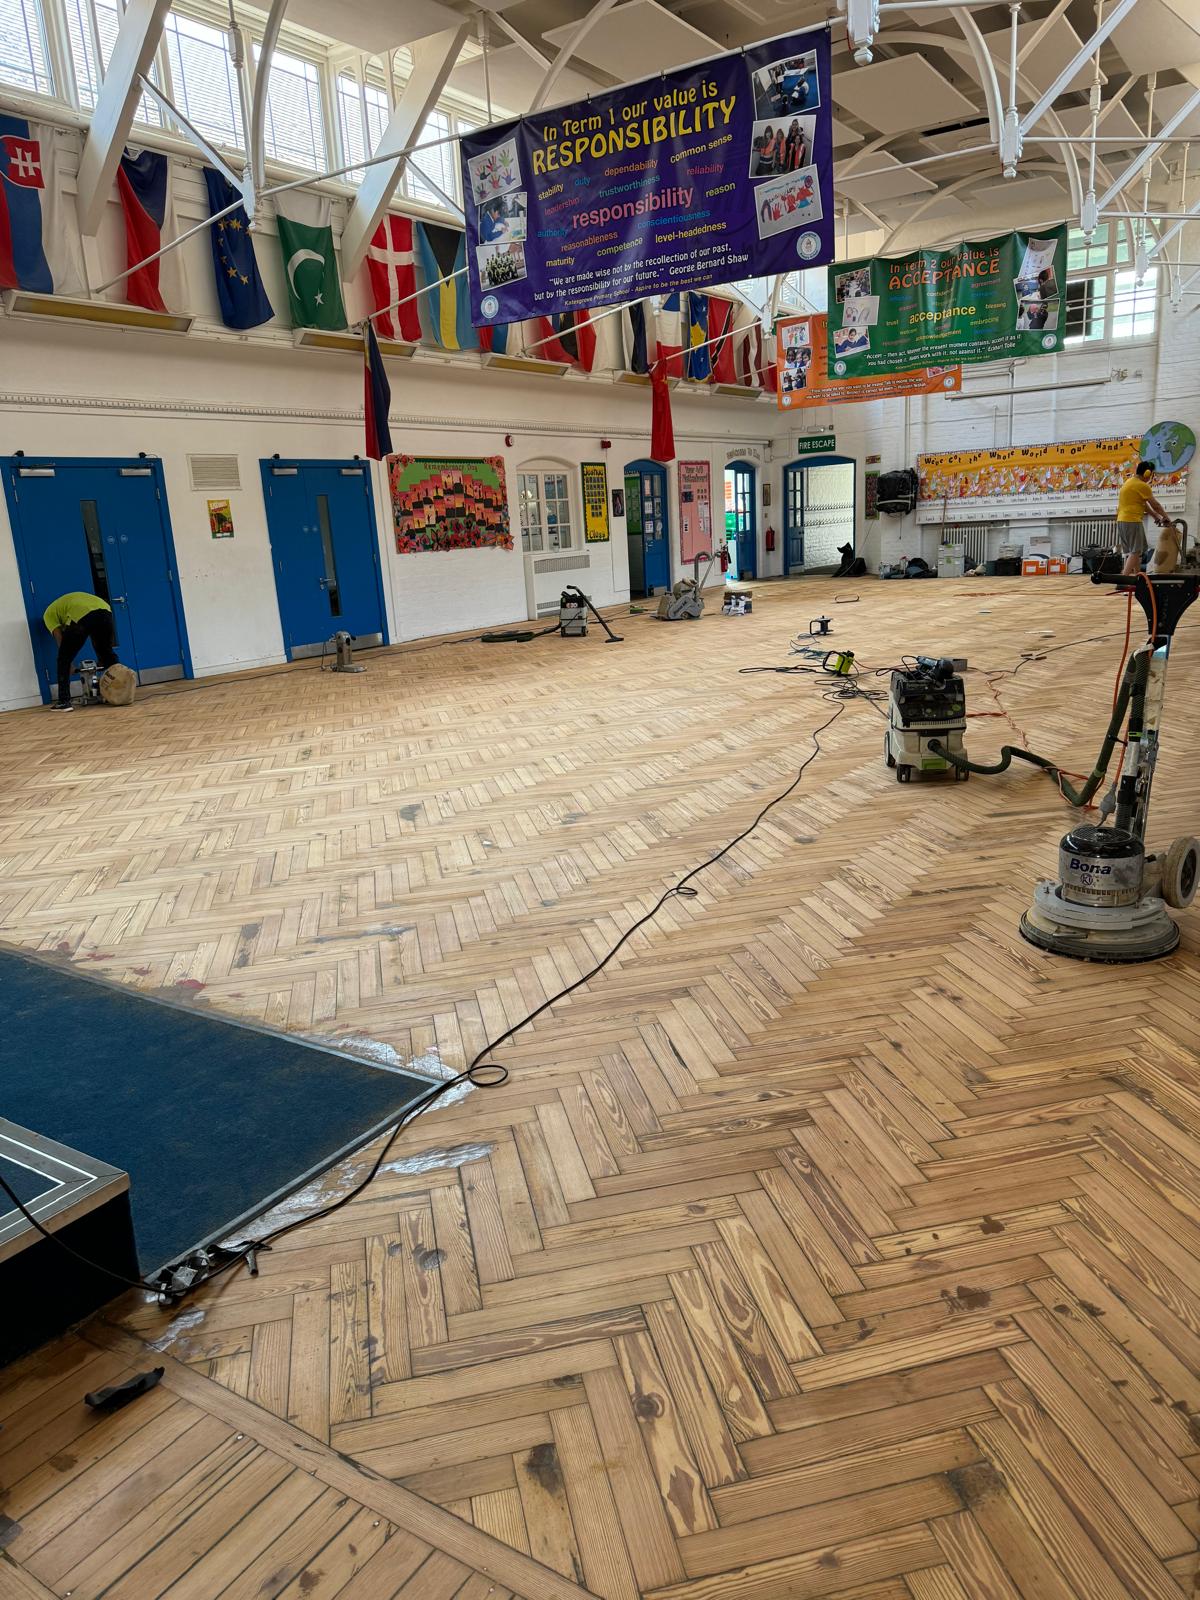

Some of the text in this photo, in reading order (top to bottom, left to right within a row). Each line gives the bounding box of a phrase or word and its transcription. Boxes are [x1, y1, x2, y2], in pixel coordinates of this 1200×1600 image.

[544, 79, 718, 142] In Term 1 our value is
[532, 95, 736, 176] RESPONSIBILITY
[670, 134, 733, 164] common sense
[604, 159, 658, 176] dependability
[686, 163, 724, 176] reliability
[538, 184, 564, 200] stability
[599, 175, 660, 198] trustworthiness
[706, 182, 736, 198] reason
[544, 197, 582, 216] leadership
[572, 186, 694, 229] responsibility
[637, 210, 711, 230] conscientiousness
[561, 231, 618, 252] reasonableness
[656, 221, 727, 244] level-headedness
[597, 237, 643, 256] competence
[546, 256, 575, 268] maturity
[564, 275, 575, 284] are
[576, 271, 594, 282] made
[595, 268, 610, 278] wise
[612, 264, 623, 274] not
[624, 262, 632, 272] by
[633, 260, 643, 269] the
[645, 252, 689, 267] recollection
[690, 248, 698, 259] of
[699, 248, 711, 256] our
[890, 248, 1000, 274] In Term 2 our value is
[534, 292, 544, 301] but
[546, 290, 554, 299] by
[556, 288, 567, 298] the
[568, 280, 611, 296] responsibility
[612, 276, 621, 286] for
[623, 275, 634, 284] our
[669, 264, 695, 275] George
[696, 256, 725, 270] Bernard
[728, 254, 749, 264] Shaw
[888, 258, 1000, 290] ACCEPTANCE
[909, 306, 976, 324] acceptance
[800, 439, 835, 450] FIRE ESCAPE
[969, 452, 982, 464] the
[989, 450, 1015, 460] Whole
[1022, 447, 1048, 458] World
[1096, 440, 1124, 451] Hands
[1070, 858, 1111, 874] Bona
